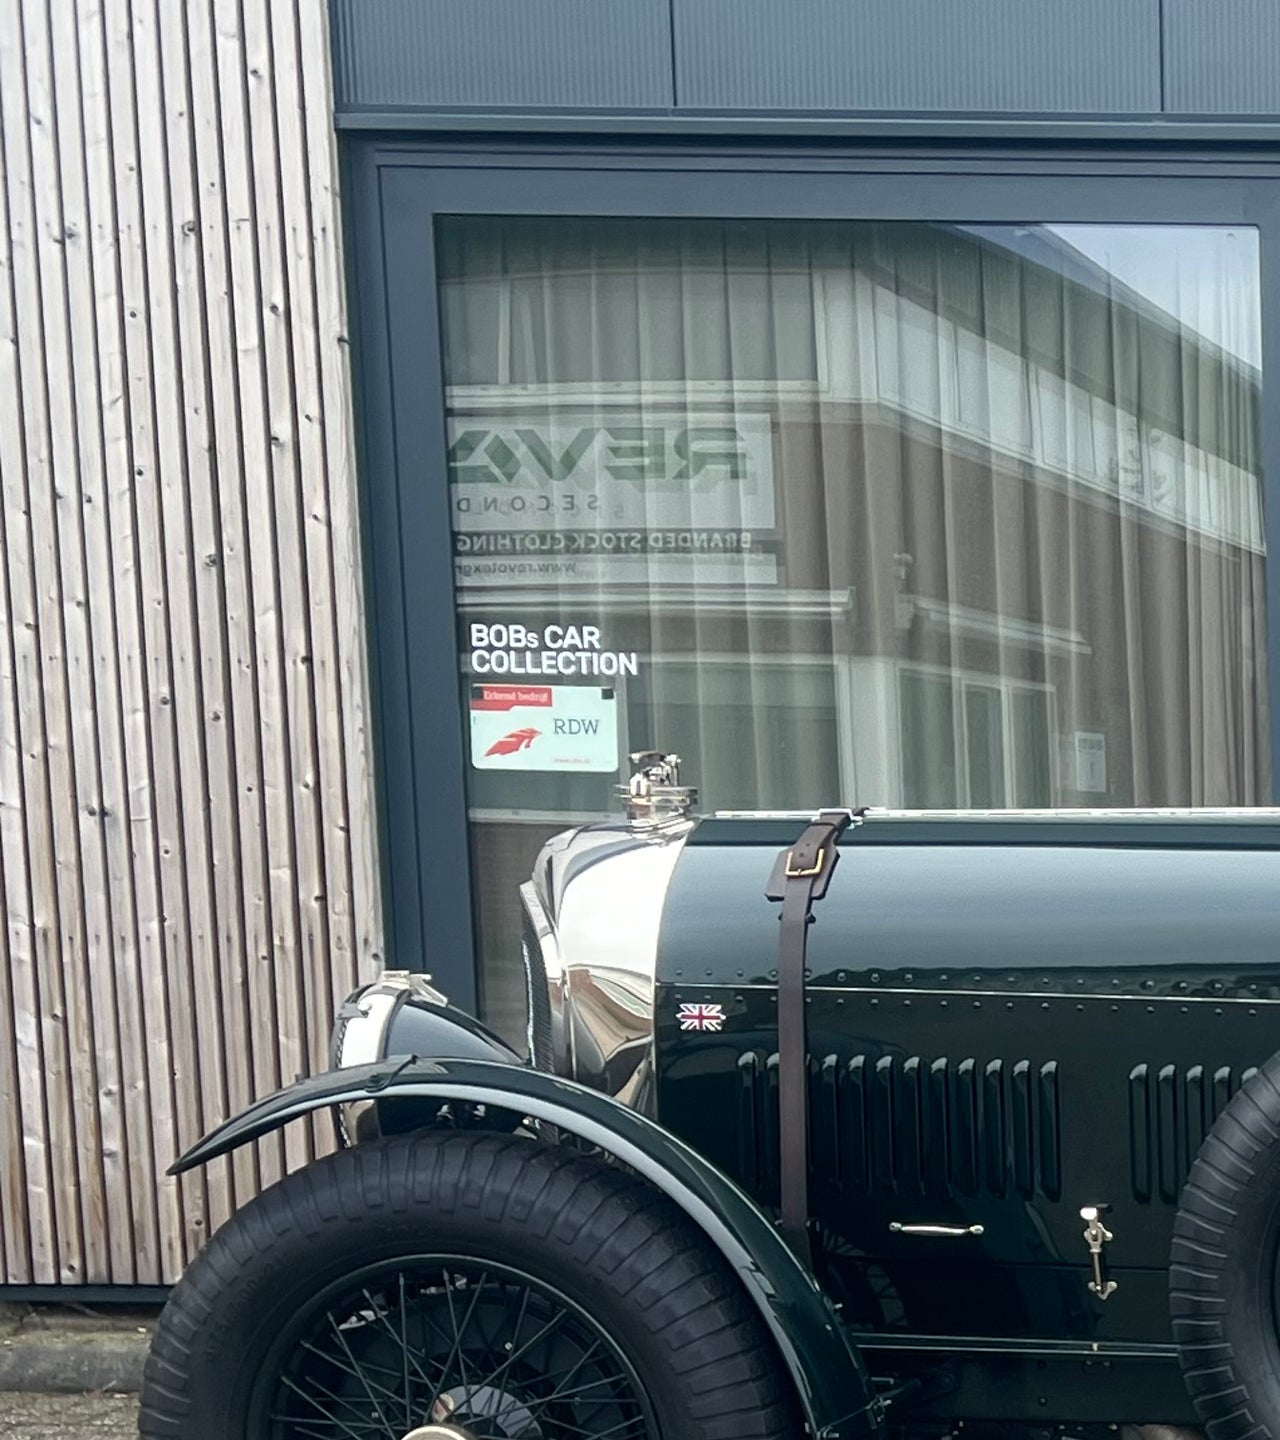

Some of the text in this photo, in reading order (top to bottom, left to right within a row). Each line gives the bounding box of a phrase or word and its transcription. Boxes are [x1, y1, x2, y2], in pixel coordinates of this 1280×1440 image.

[470, 623, 601, 649] BOBs CAR
[471, 649, 638, 676] COLLECTION
[553, 718, 600, 735] RDW
